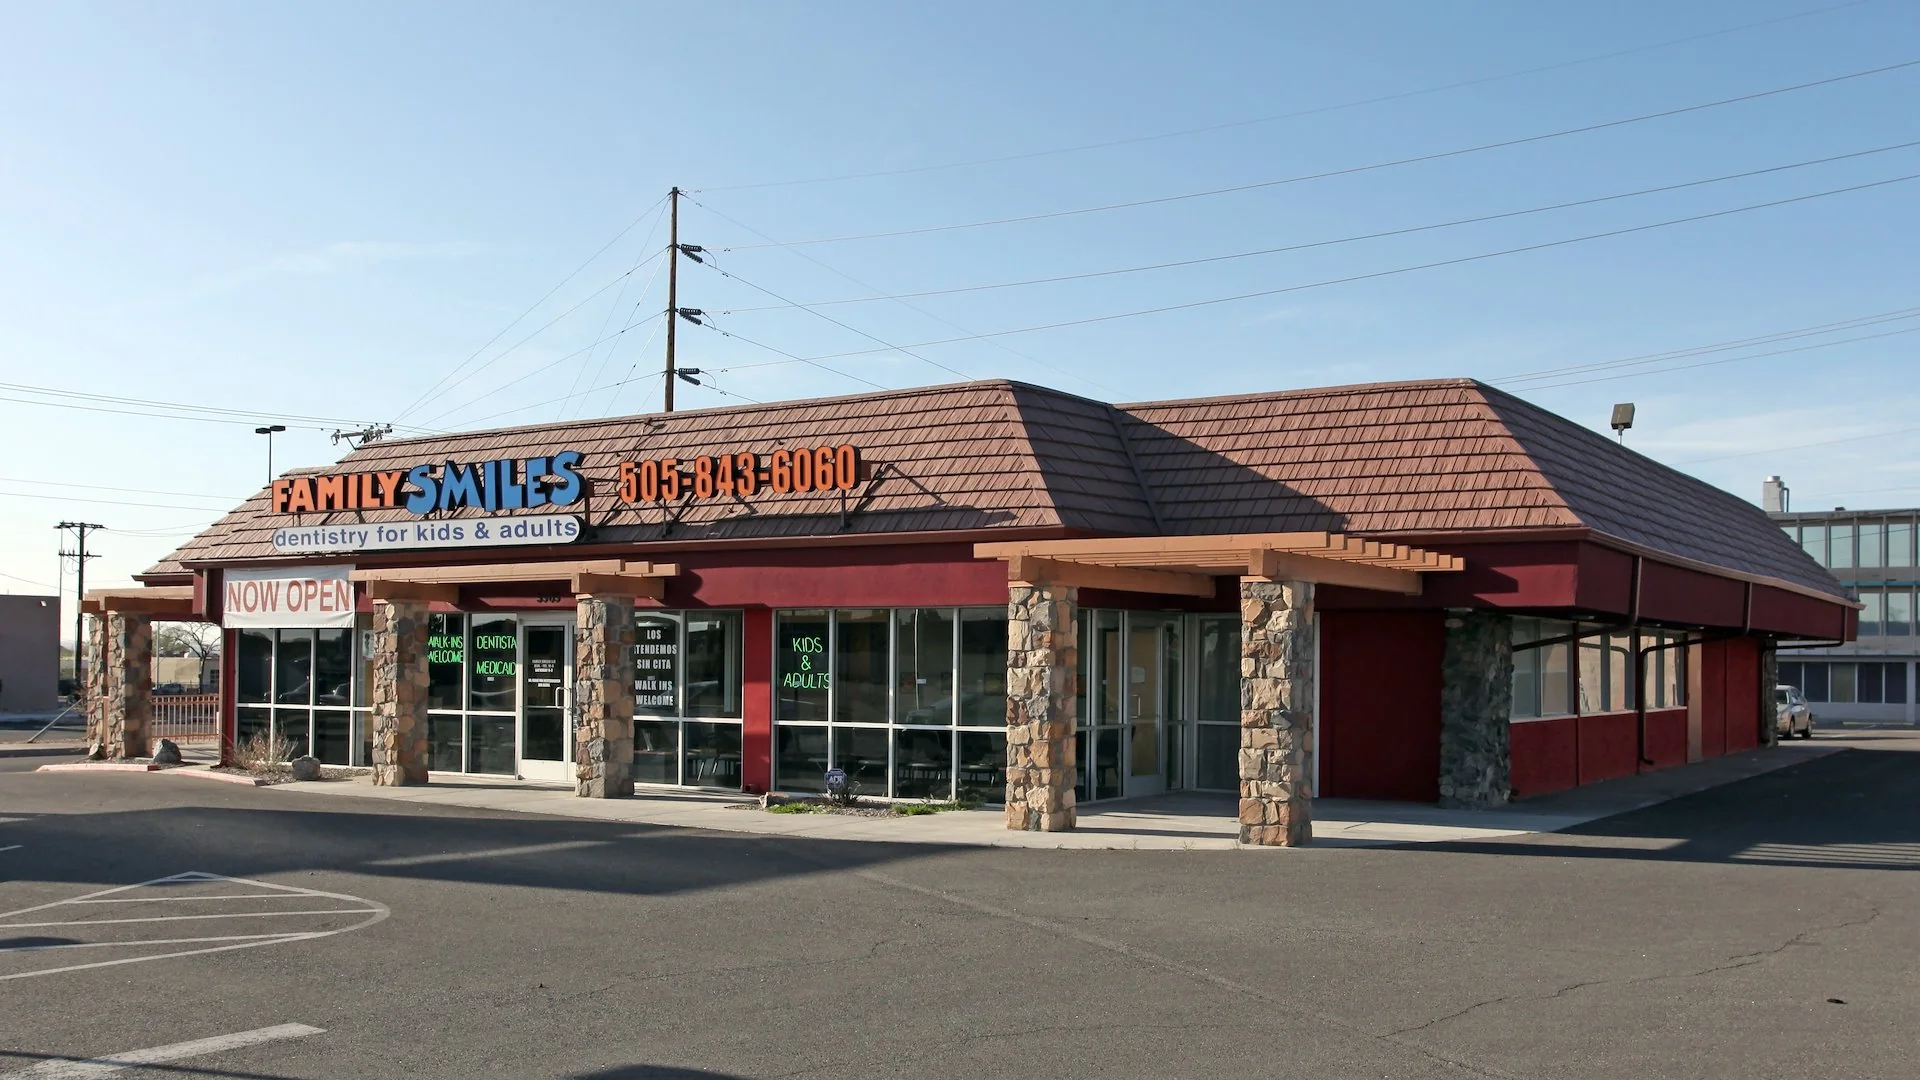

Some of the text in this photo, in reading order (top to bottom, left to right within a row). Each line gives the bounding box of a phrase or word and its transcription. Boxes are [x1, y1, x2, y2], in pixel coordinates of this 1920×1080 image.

[620, 444, 857, 503] 505-843-6060
[272, 450, 582, 515] FAMILY SMILES
[275, 517, 578, 548] dentistry for kids & adults
[227, 578, 351, 613] NOW OPEN
[646, 629, 662, 640] LOS
[477, 635, 517, 650] DENTISTA
[633, 644, 677, 655] TENDEMOS
[792, 637, 823, 653] KIDS
[477, 660, 516, 675] MEDICAID
[636, 659, 671, 669] SIN CITA
[800, 655, 811, 671] &
[634, 680, 673, 690] WALK INS
[783, 673, 829, 689] ADULTS
[635, 695, 674, 706] WELCOME
